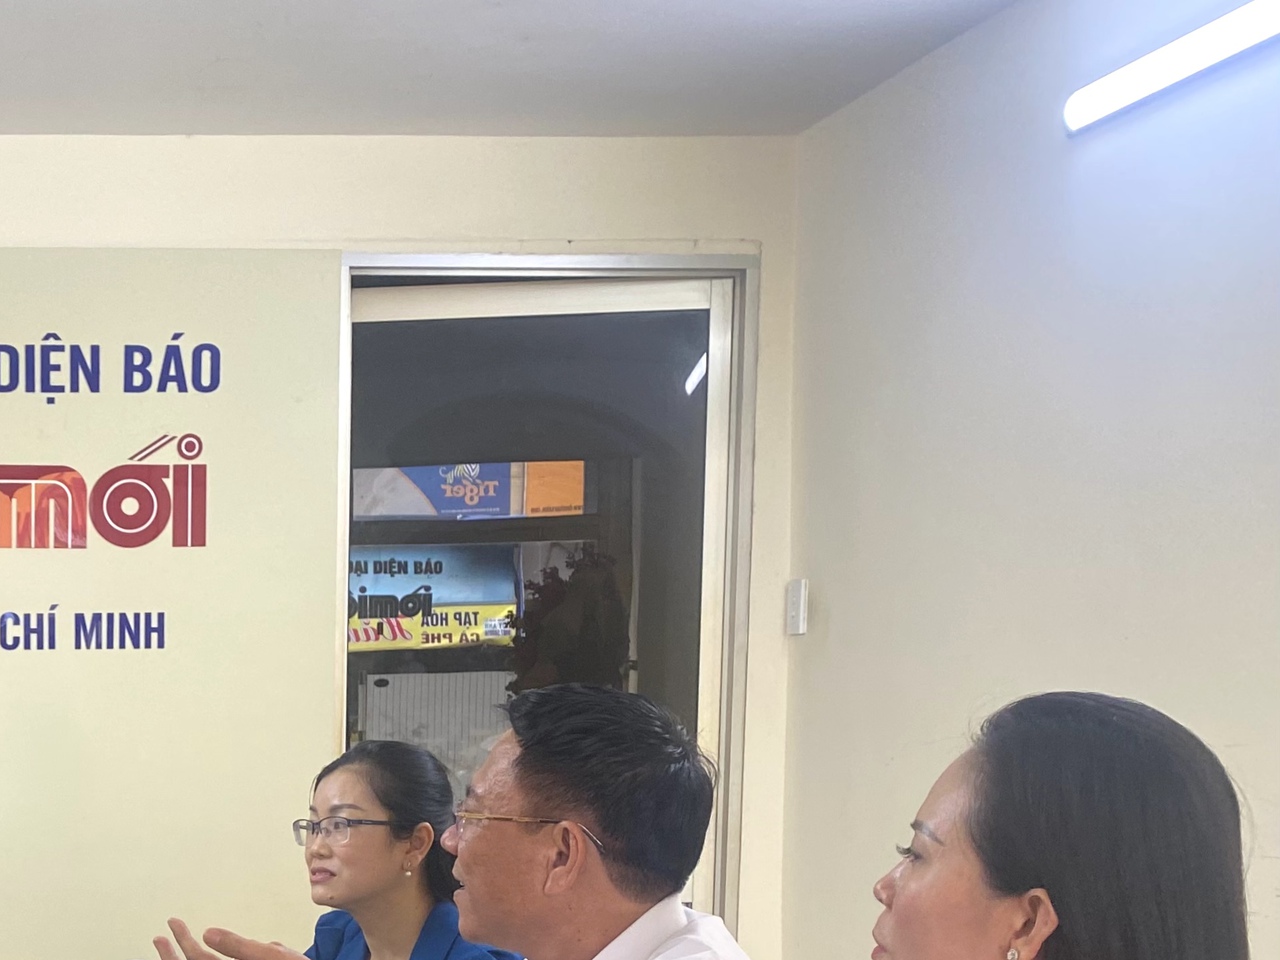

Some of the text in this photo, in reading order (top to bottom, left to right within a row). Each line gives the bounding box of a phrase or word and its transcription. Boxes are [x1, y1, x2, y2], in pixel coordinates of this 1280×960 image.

[122, 332, 221, 394] BÁO
[373, 557, 409, 578] DIỆN
[413, 557, 443, 575] BÁO
[0, 603, 59, 651] CHÍ
[74, 612, 165, 650] MINH
